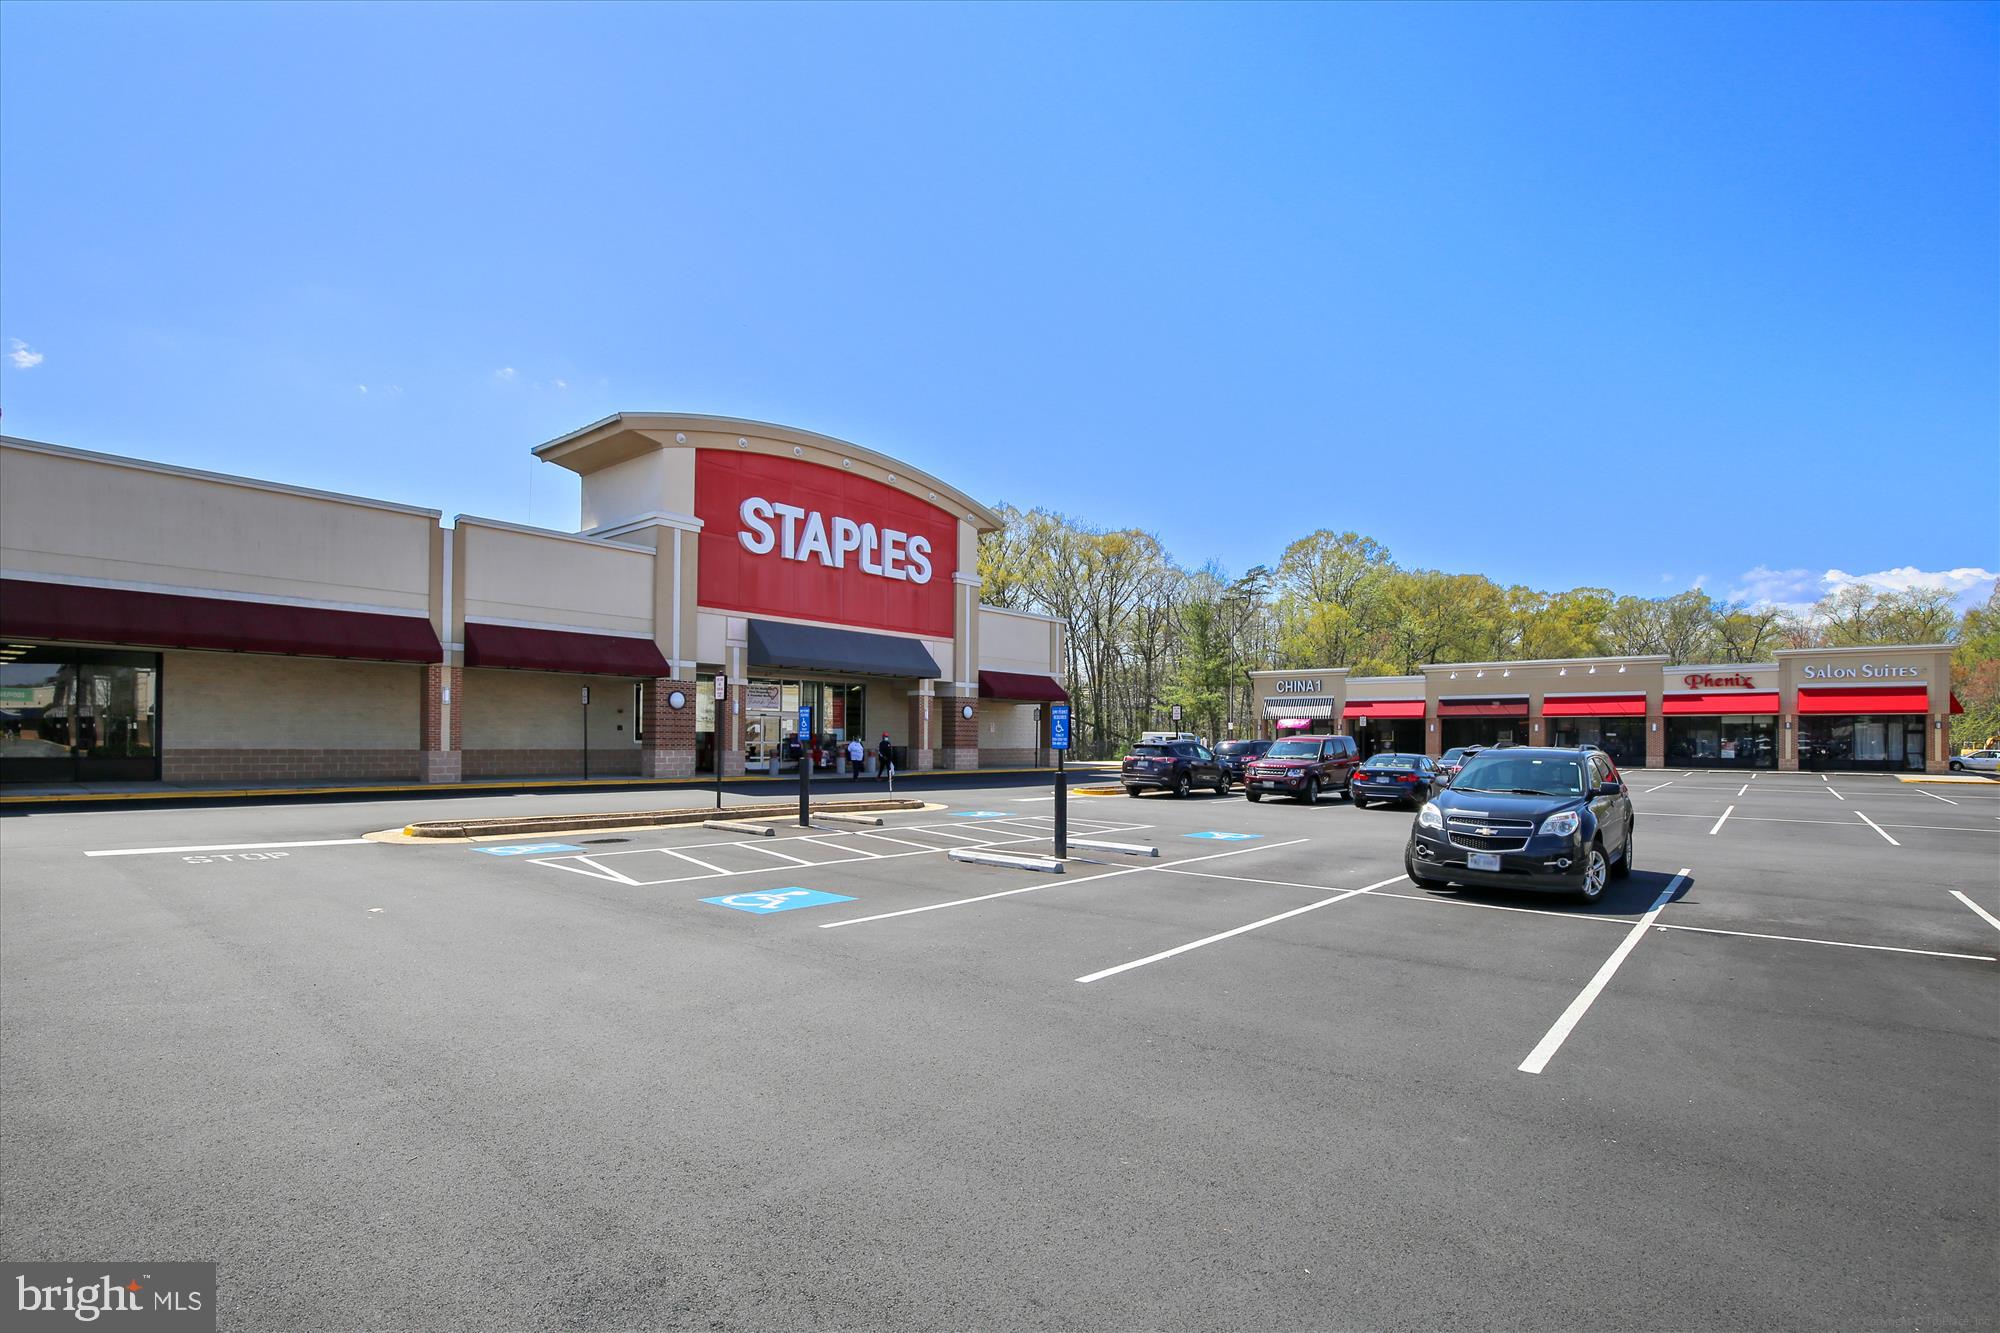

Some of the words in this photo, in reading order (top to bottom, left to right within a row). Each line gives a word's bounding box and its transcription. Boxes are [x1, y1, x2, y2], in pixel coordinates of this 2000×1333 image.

[738, 497, 932, 584] STAPLES
[1683, 673, 1756, 690] Phenix
[182, 852, 290, 864] STOP
